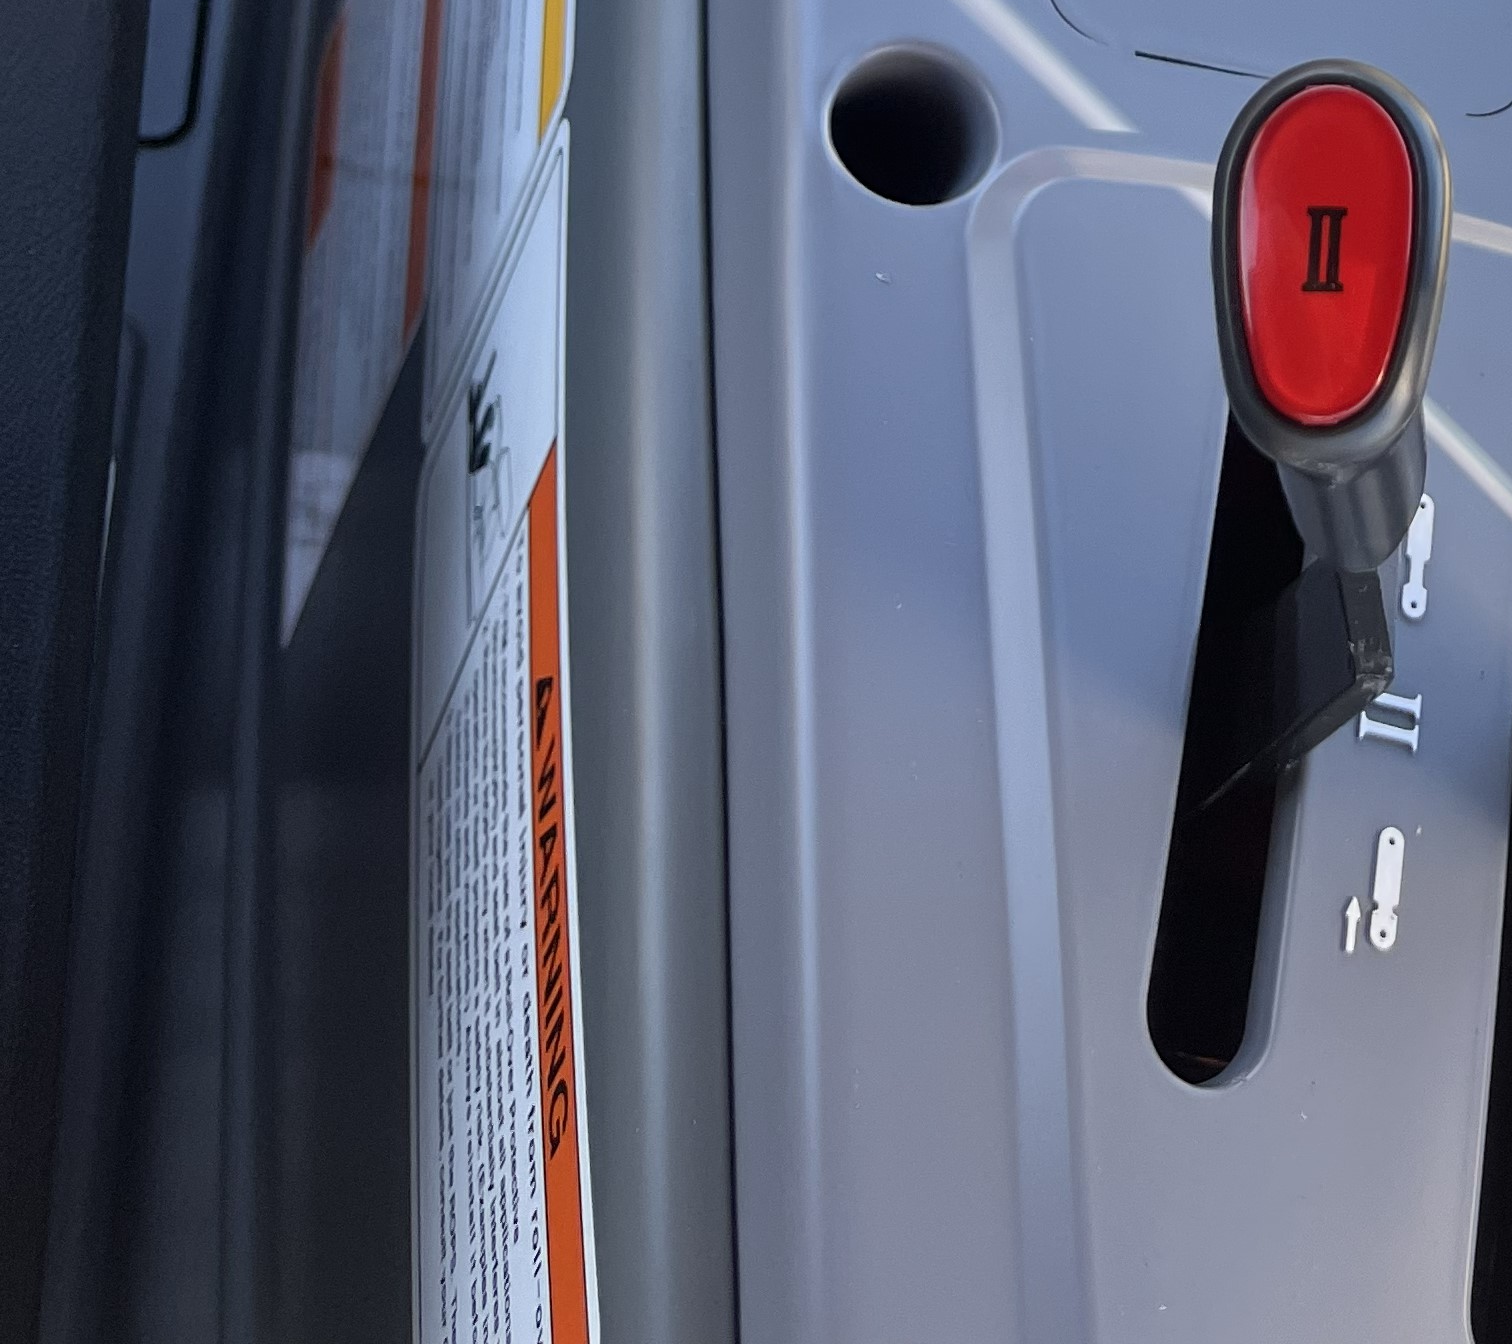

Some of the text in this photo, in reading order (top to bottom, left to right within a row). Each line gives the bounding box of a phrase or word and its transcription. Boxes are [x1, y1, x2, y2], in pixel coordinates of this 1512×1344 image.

[1301, 205, 1349, 293] II
[537, 735, 569, 1160] WARNING
[524, 992, 533, 1097] death
[485, 1023, 494, 1191] substantially
[491, 1197, 499, 1333] interferes
[510, 1100, 518, 1244] Protective
[528, 1105, 536, 1199] from
